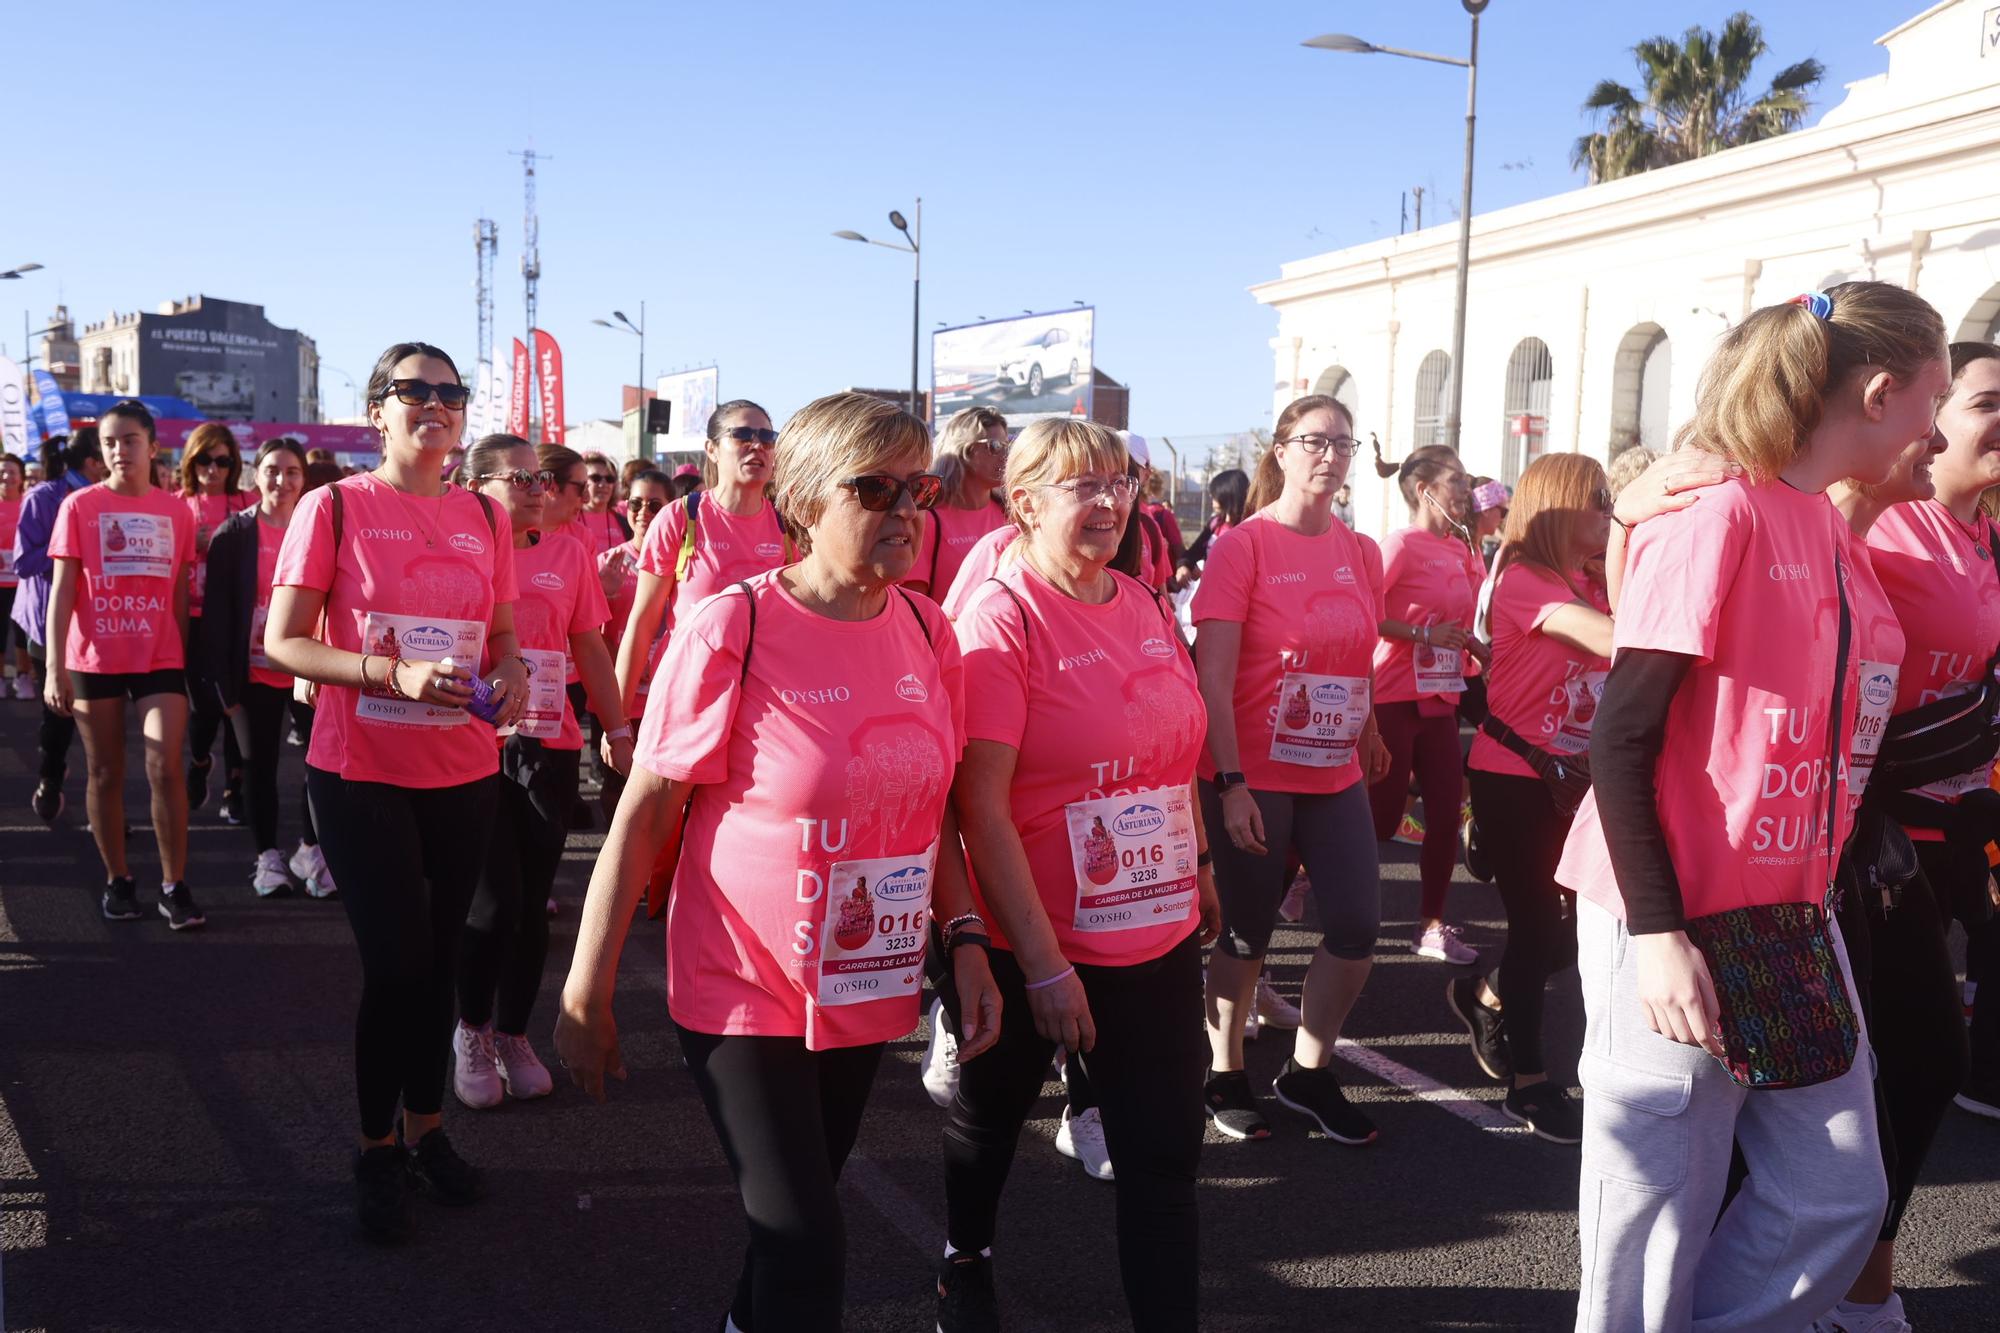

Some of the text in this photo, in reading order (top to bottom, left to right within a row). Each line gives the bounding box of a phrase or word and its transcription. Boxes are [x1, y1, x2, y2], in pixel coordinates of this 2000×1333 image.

[165, 328, 207, 343] PUERTO
[360, 528, 412, 541] OYSHO
[1265, 572, 1306, 584] OYSHO
[1769, 563, 1810, 580] OYSHO
[92, 575, 115, 590] TU
[95, 596, 165, 612] DORSAL
[95, 618, 152, 633] SUMA
[406, 634, 449, 646] ASTURIANA
[1278, 649, 1308, 669] TU
[1929, 650, 1973, 680] TU
[781, 686, 850, 704] OYSHO
[368, 703, 406, 715] OYSHO
[1312, 712, 1343, 725] 016
[1763, 706, 1808, 744] TU
[1859, 715, 1881, 734] 016
[1316, 728, 1336, 737] 3239
[1280, 748, 1311, 759] OYSHO
[1091, 756, 1134, 787] TU
[1761, 751, 1849, 799] DORSA
[1167, 804, 1185, 813] SUMA
[1118, 816, 1161, 831] ASTURIANA
[1752, 807, 1829, 852] SUMA
[795, 817, 848, 853] TU
[1121, 844, 1164, 868] 016
[1130, 869, 1158, 883] 3238
[1095, 895, 1130, 905] CARRERA
[1154, 884, 1178, 894] MUJER
[878, 910, 923, 934] 016
[1089, 911, 1132, 923] OYSHO
[885, 936, 916, 950] 3233
[791, 960, 819, 968] CARRE
[838, 961, 880, 971] CARRERA
[882, 959, 894, 967] DE
[834, 979, 879, 995] OYSHO
